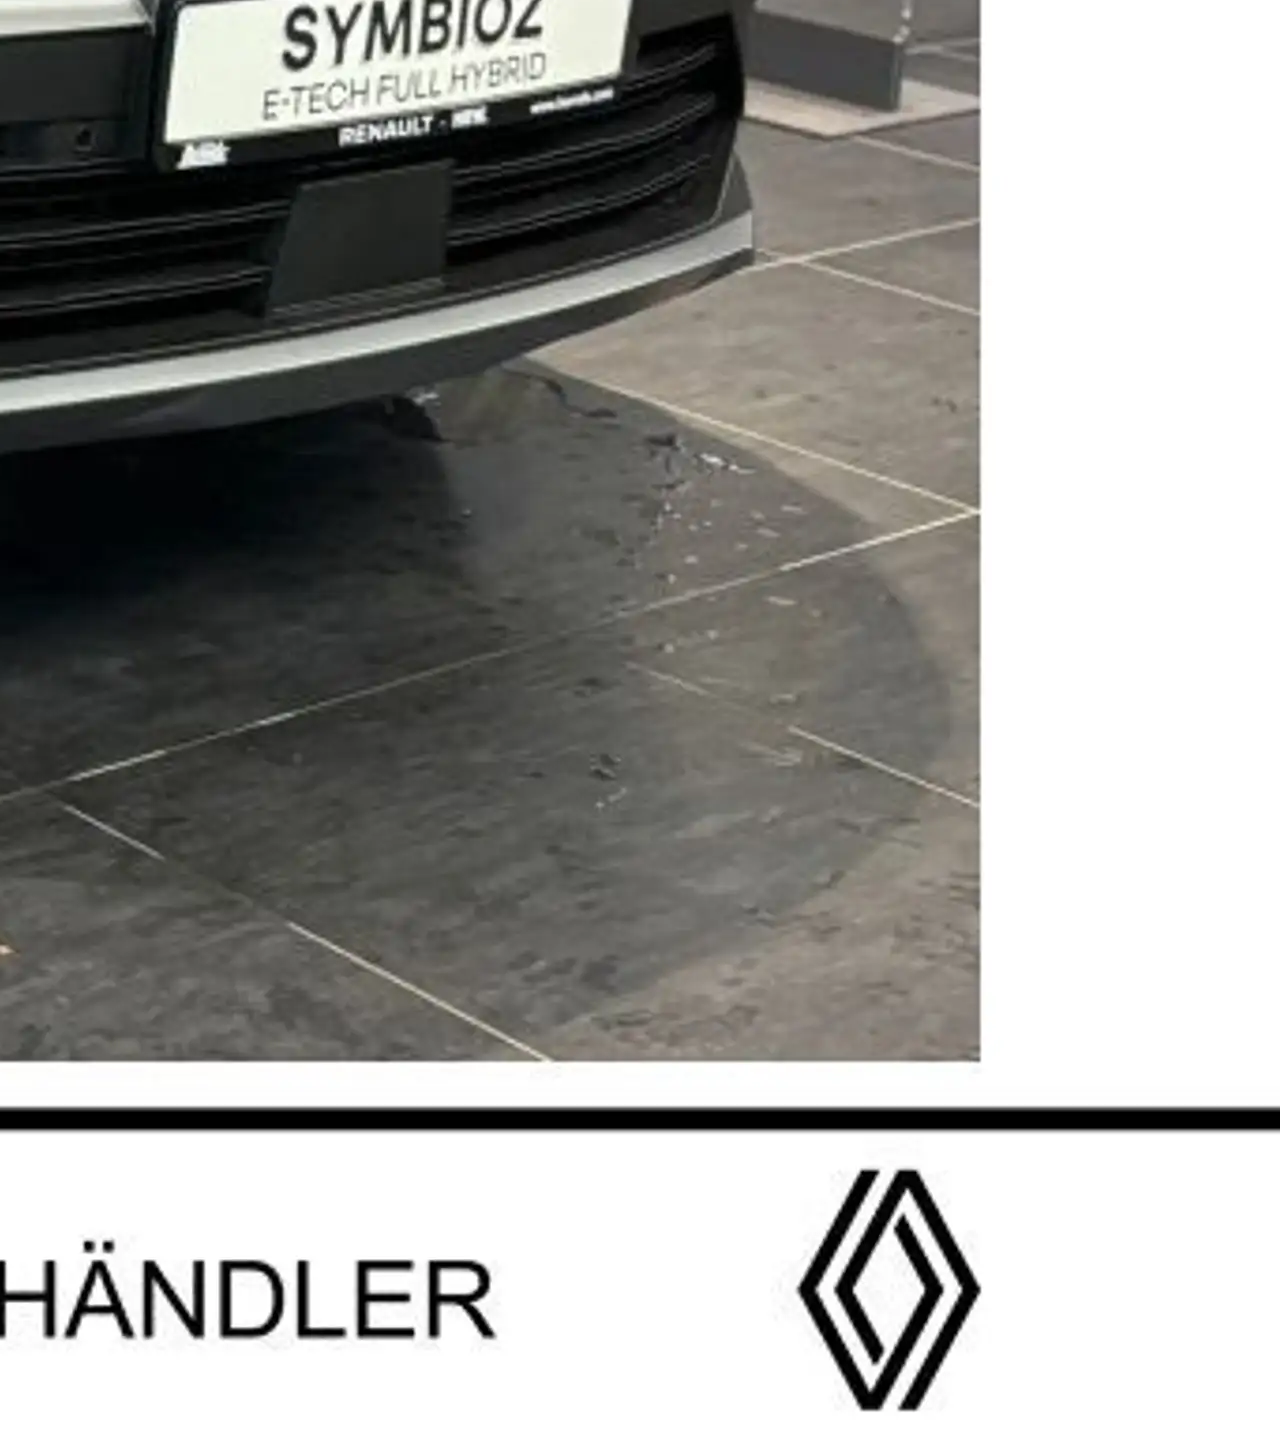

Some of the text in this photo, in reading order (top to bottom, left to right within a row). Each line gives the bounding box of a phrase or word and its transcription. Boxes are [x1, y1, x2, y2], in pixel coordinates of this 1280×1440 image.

[261, 51, 548, 122] E-TECH FULL HYBRID
[339, 114, 434, 146] RENAULT
